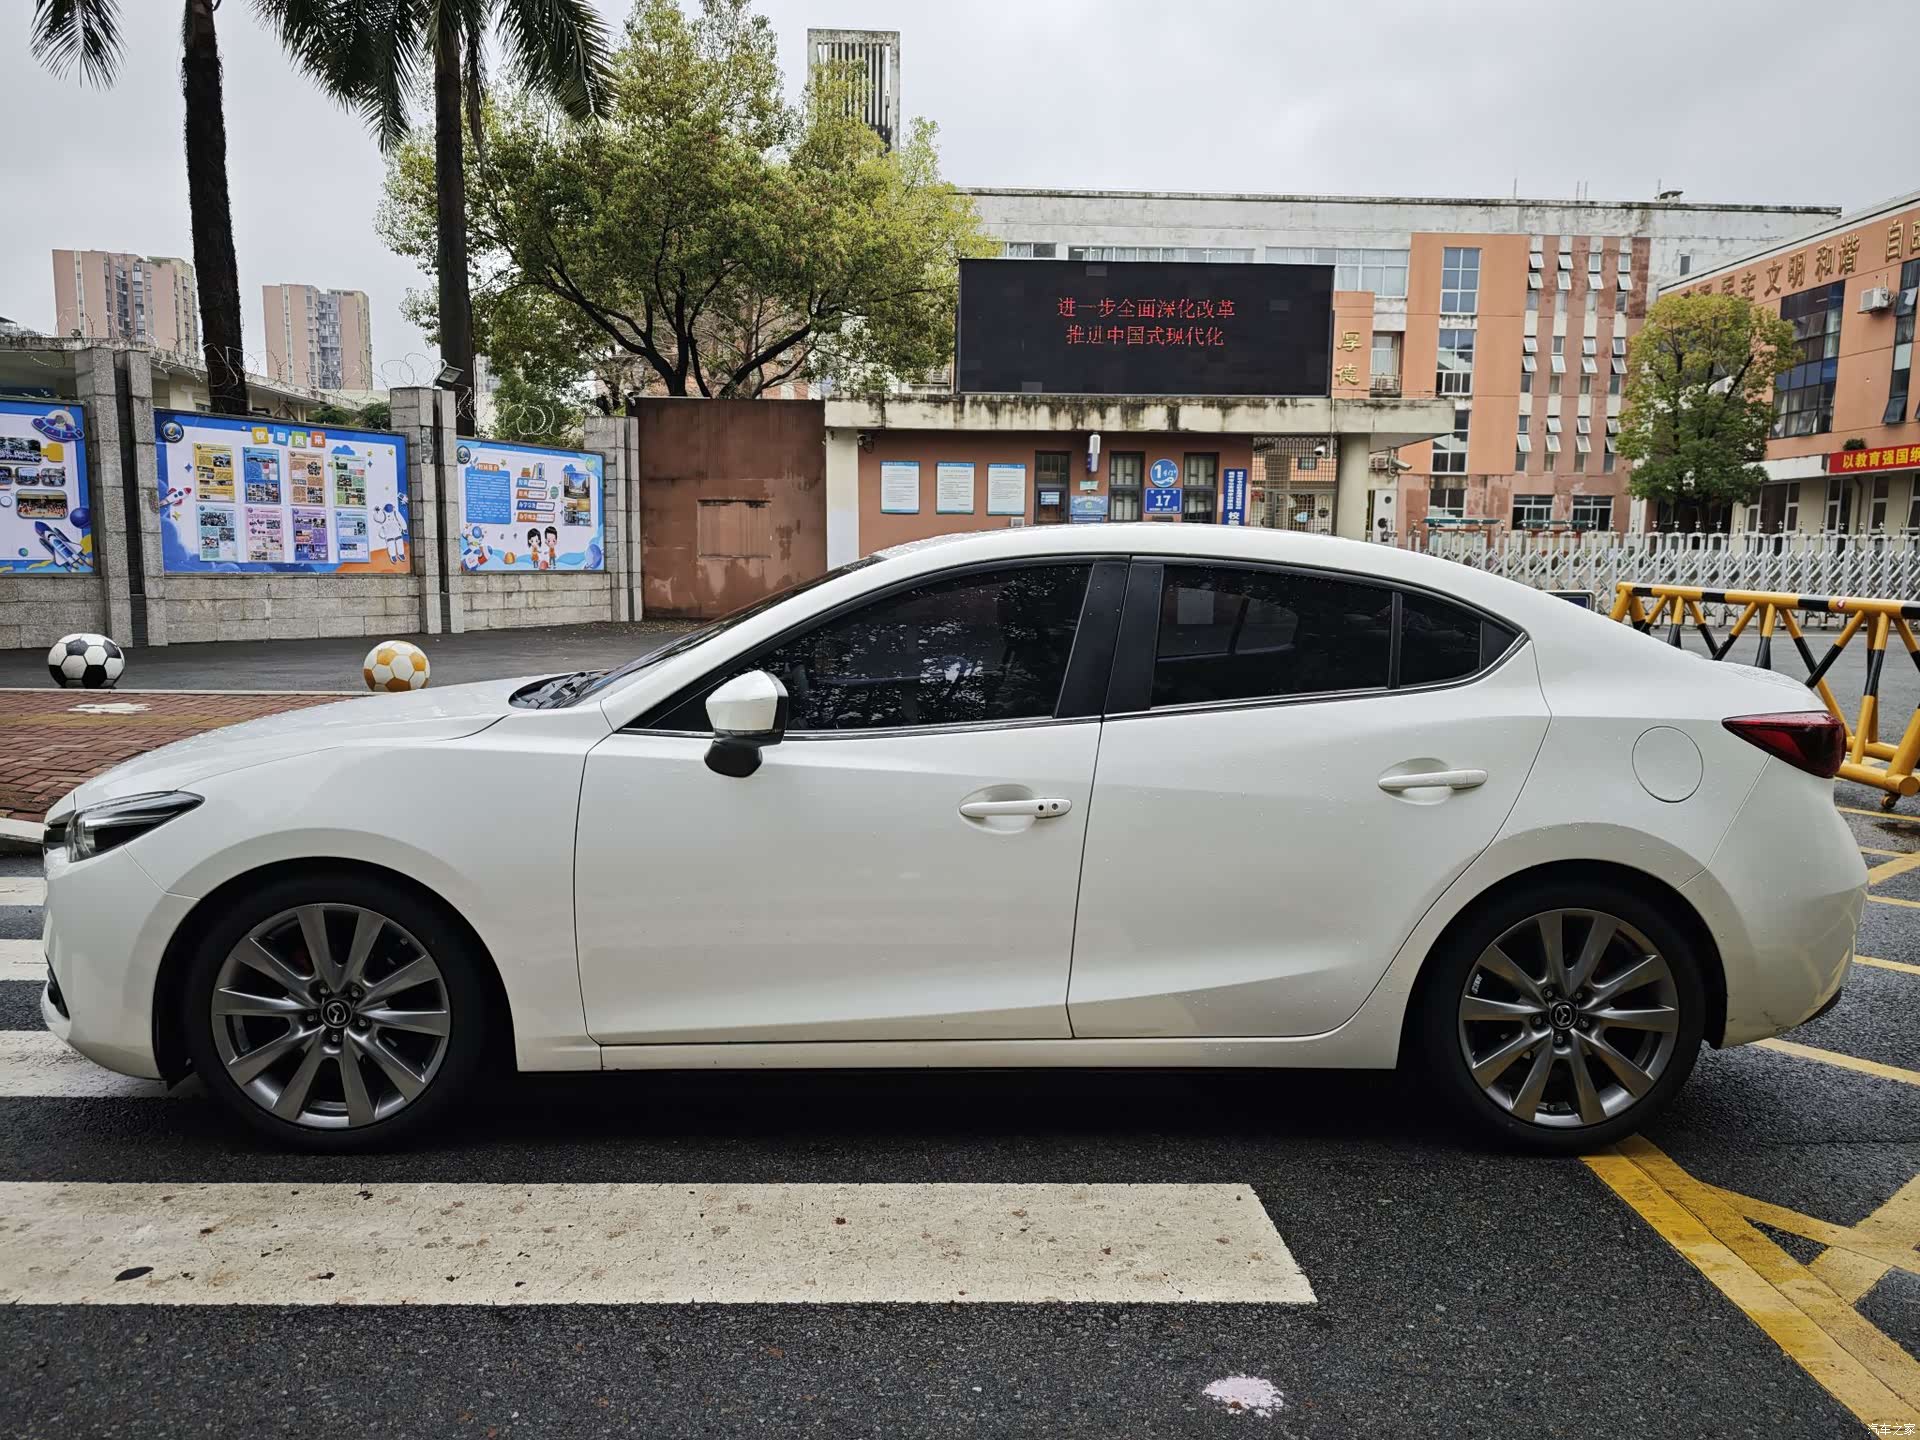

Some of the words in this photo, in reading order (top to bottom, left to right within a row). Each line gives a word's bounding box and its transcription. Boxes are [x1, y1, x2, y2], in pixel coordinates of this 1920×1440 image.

[1057, 297, 1236, 319] 进一步全面深化改革
[1066, 324, 1226, 346] 推进中国式现代化
[1335, 330, 1363, 386] 厚德
[1155, 494, 1171, 507] 17
